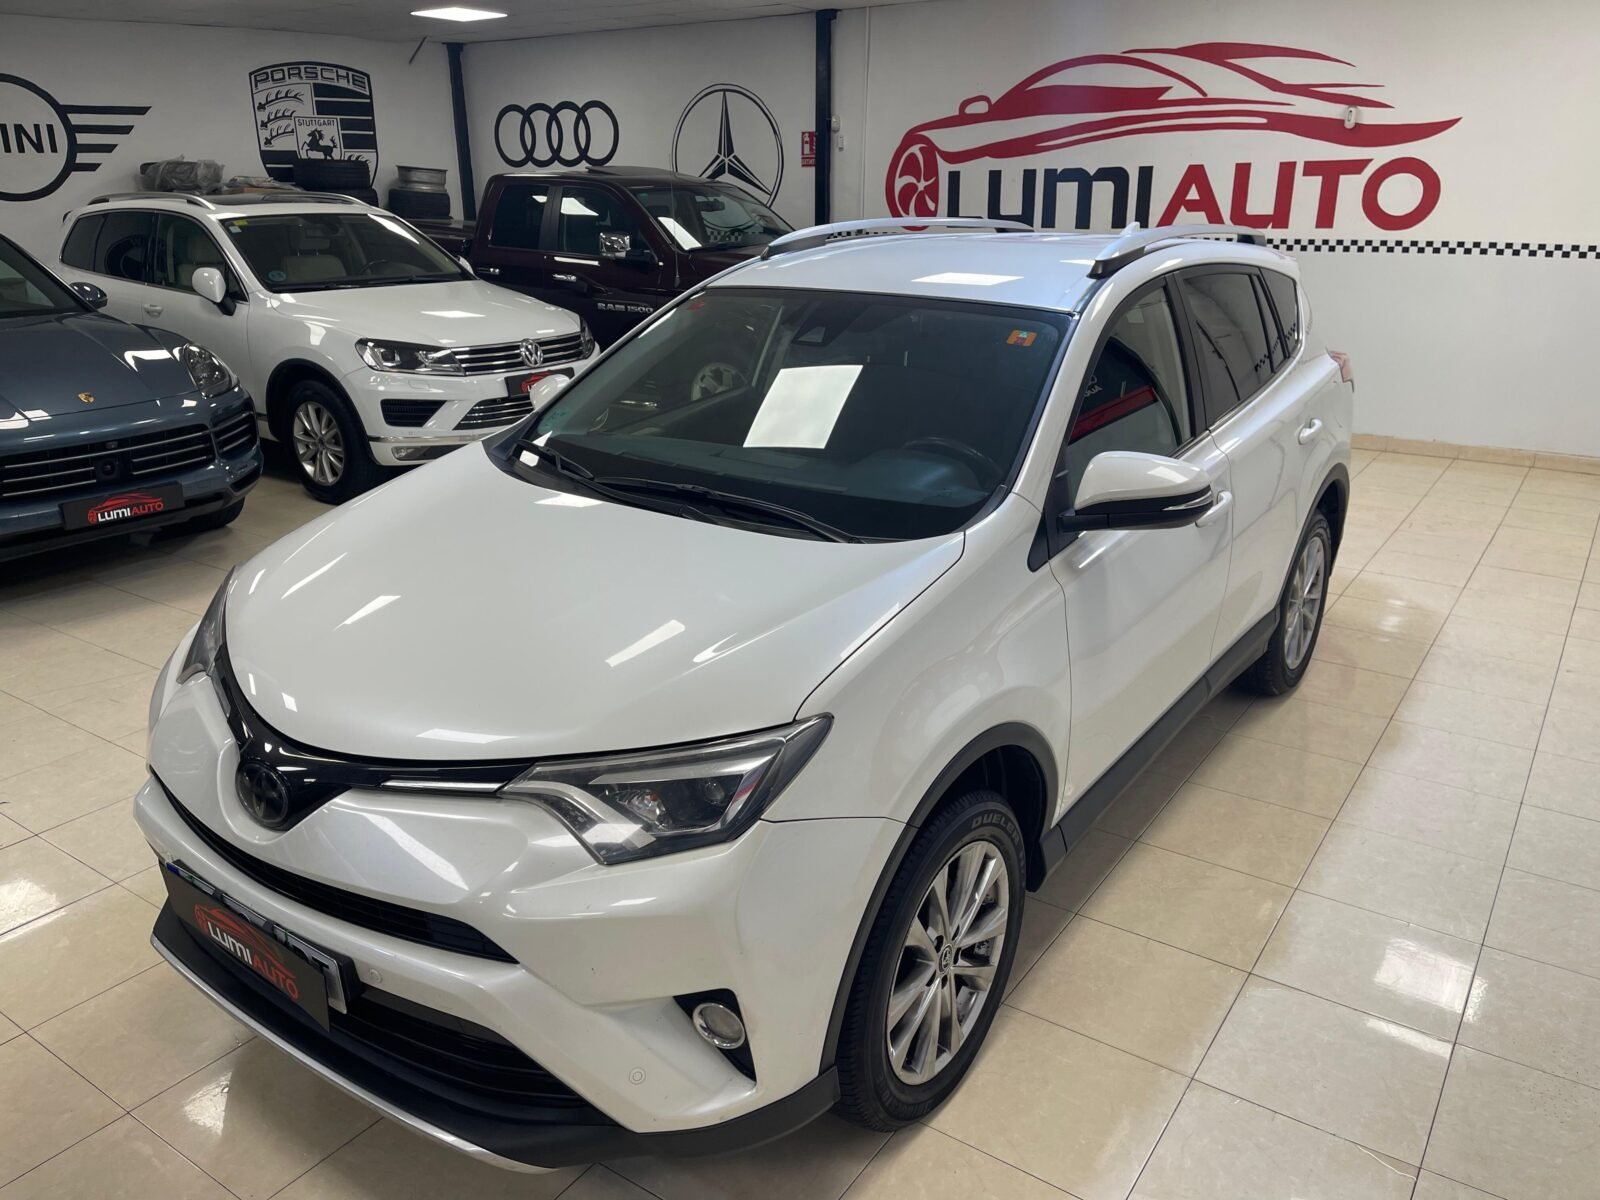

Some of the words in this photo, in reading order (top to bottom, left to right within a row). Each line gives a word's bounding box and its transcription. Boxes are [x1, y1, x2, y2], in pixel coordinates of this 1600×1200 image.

[253, 66, 368, 92] PORSCHE
[297, 118, 336, 127] STUTTGART
[0, 123, 58, 154] INI
[597, 302, 626, 312] RAM
[627, 305, 654, 314] 1500
